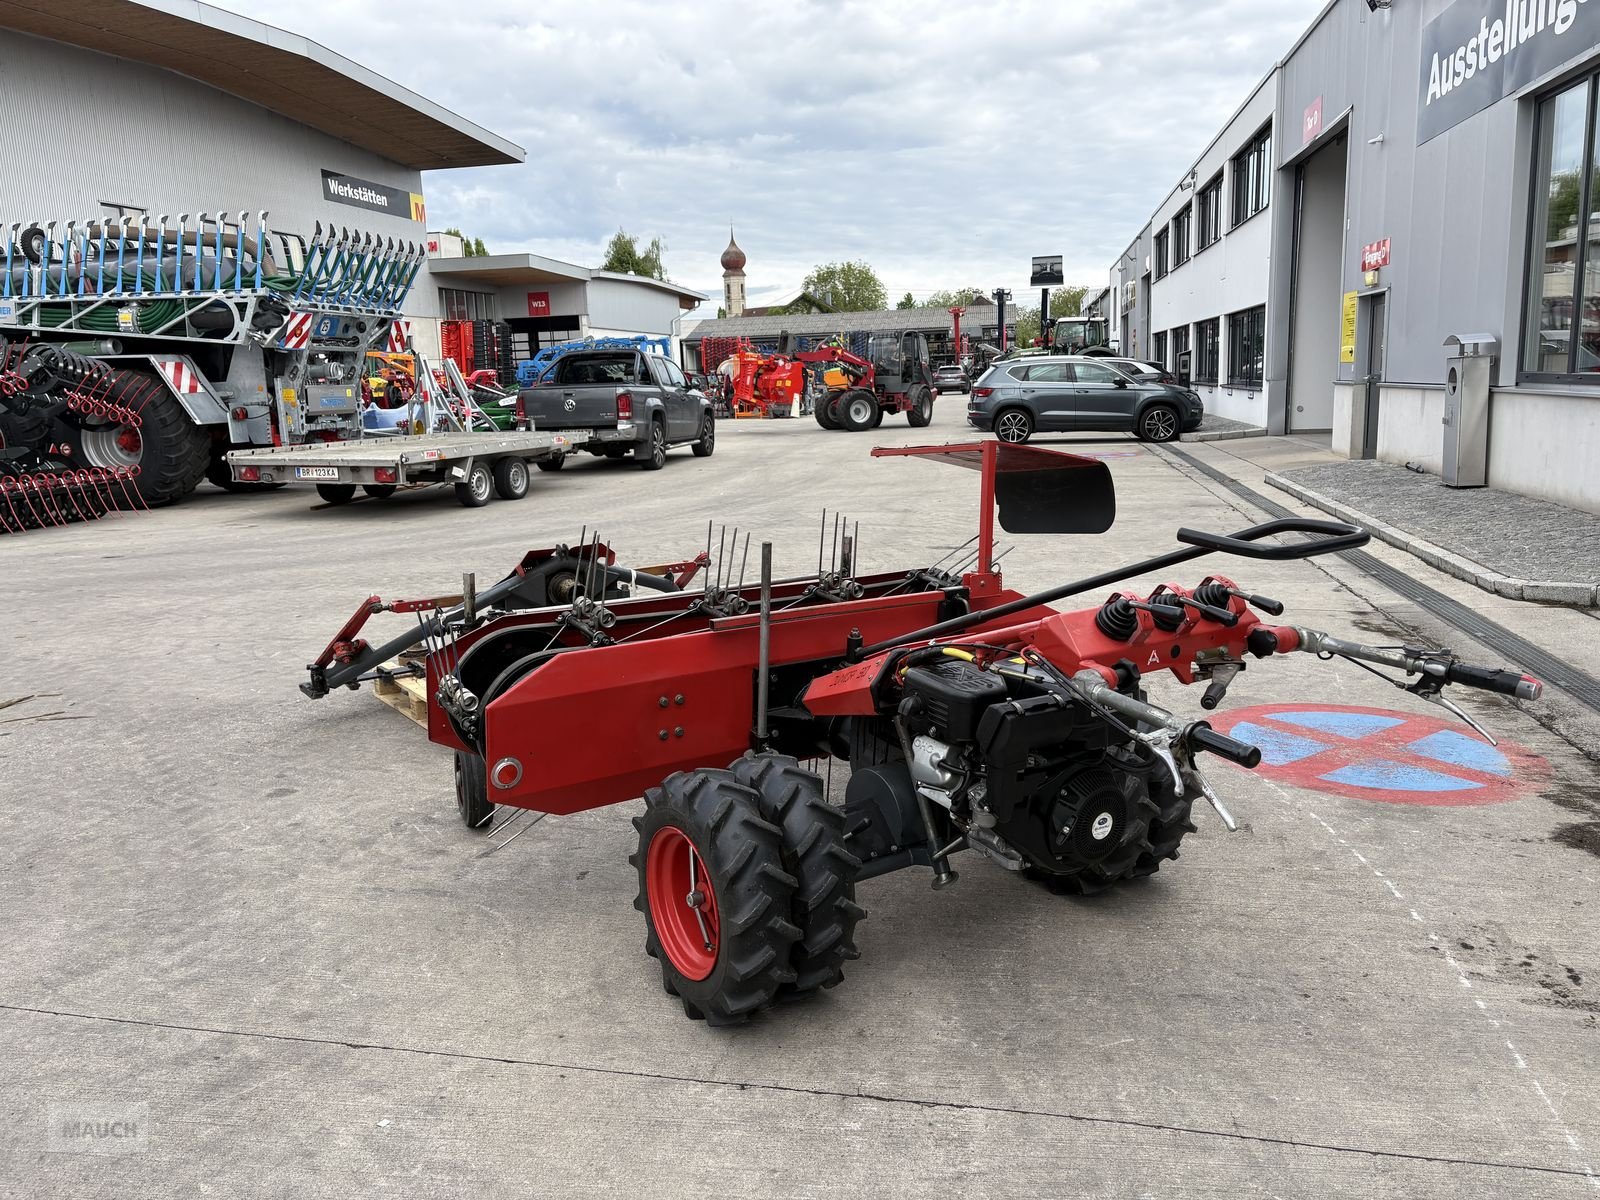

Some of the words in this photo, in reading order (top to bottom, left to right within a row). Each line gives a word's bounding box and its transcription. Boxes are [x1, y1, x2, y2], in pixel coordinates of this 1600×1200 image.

[1425, 0, 1589, 106] Ausstellung
[328, 178, 388, 207] Werkstätten
[532, 300, 546, 308] W13
[321, 321, 330, 332] 25
[913, 738, 934, 754] OHC
